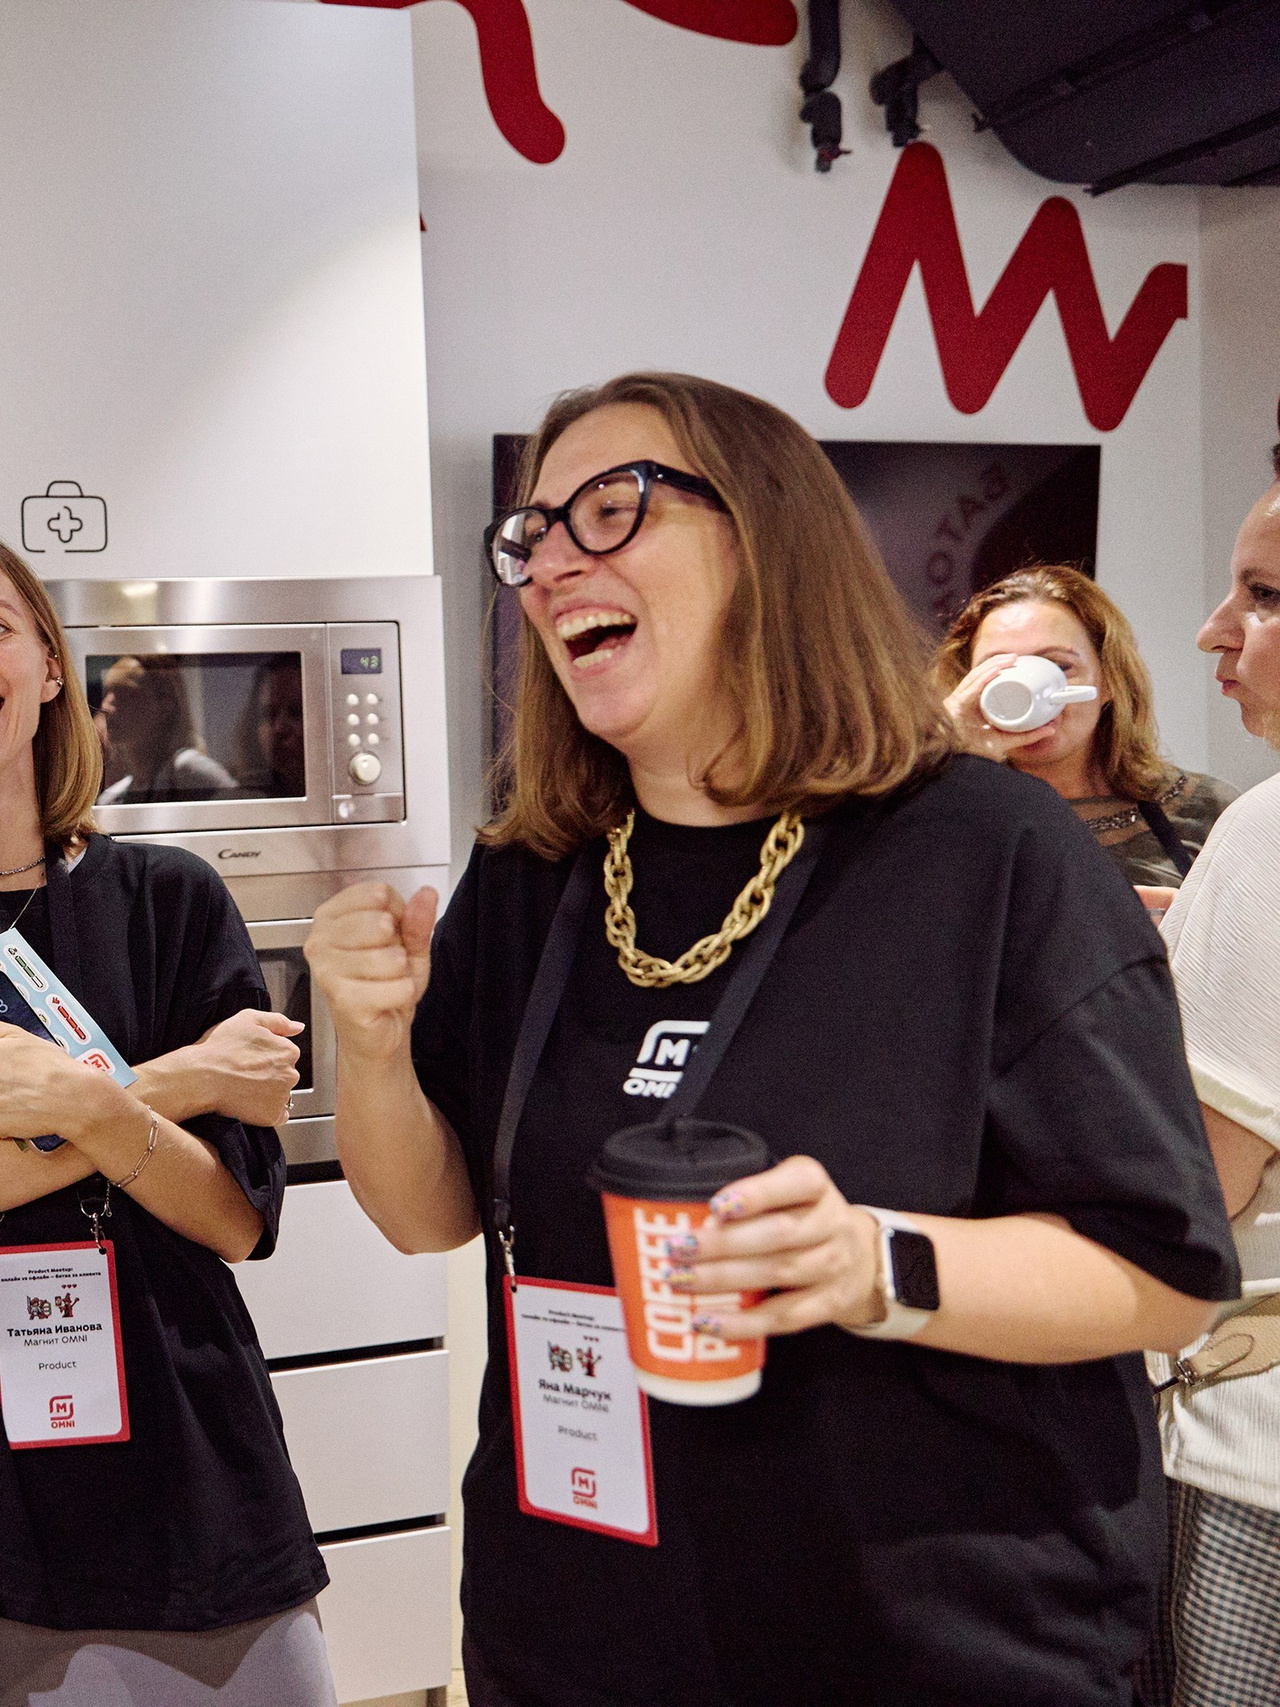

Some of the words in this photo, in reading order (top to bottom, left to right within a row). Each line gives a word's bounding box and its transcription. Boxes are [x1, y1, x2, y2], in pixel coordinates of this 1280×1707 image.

[7, 1327, 53, 1337] Татьяна
[54, 1323, 103, 1334] Иванова
[23, 1337, 59, 1347] Магнит
[61, 1334, 88, 1344] OMNI
[38, 1361, 77, 1370] Product
[538, 1378, 560, 1392] Яна
[51, 1420, 76, 1429] OMNI
